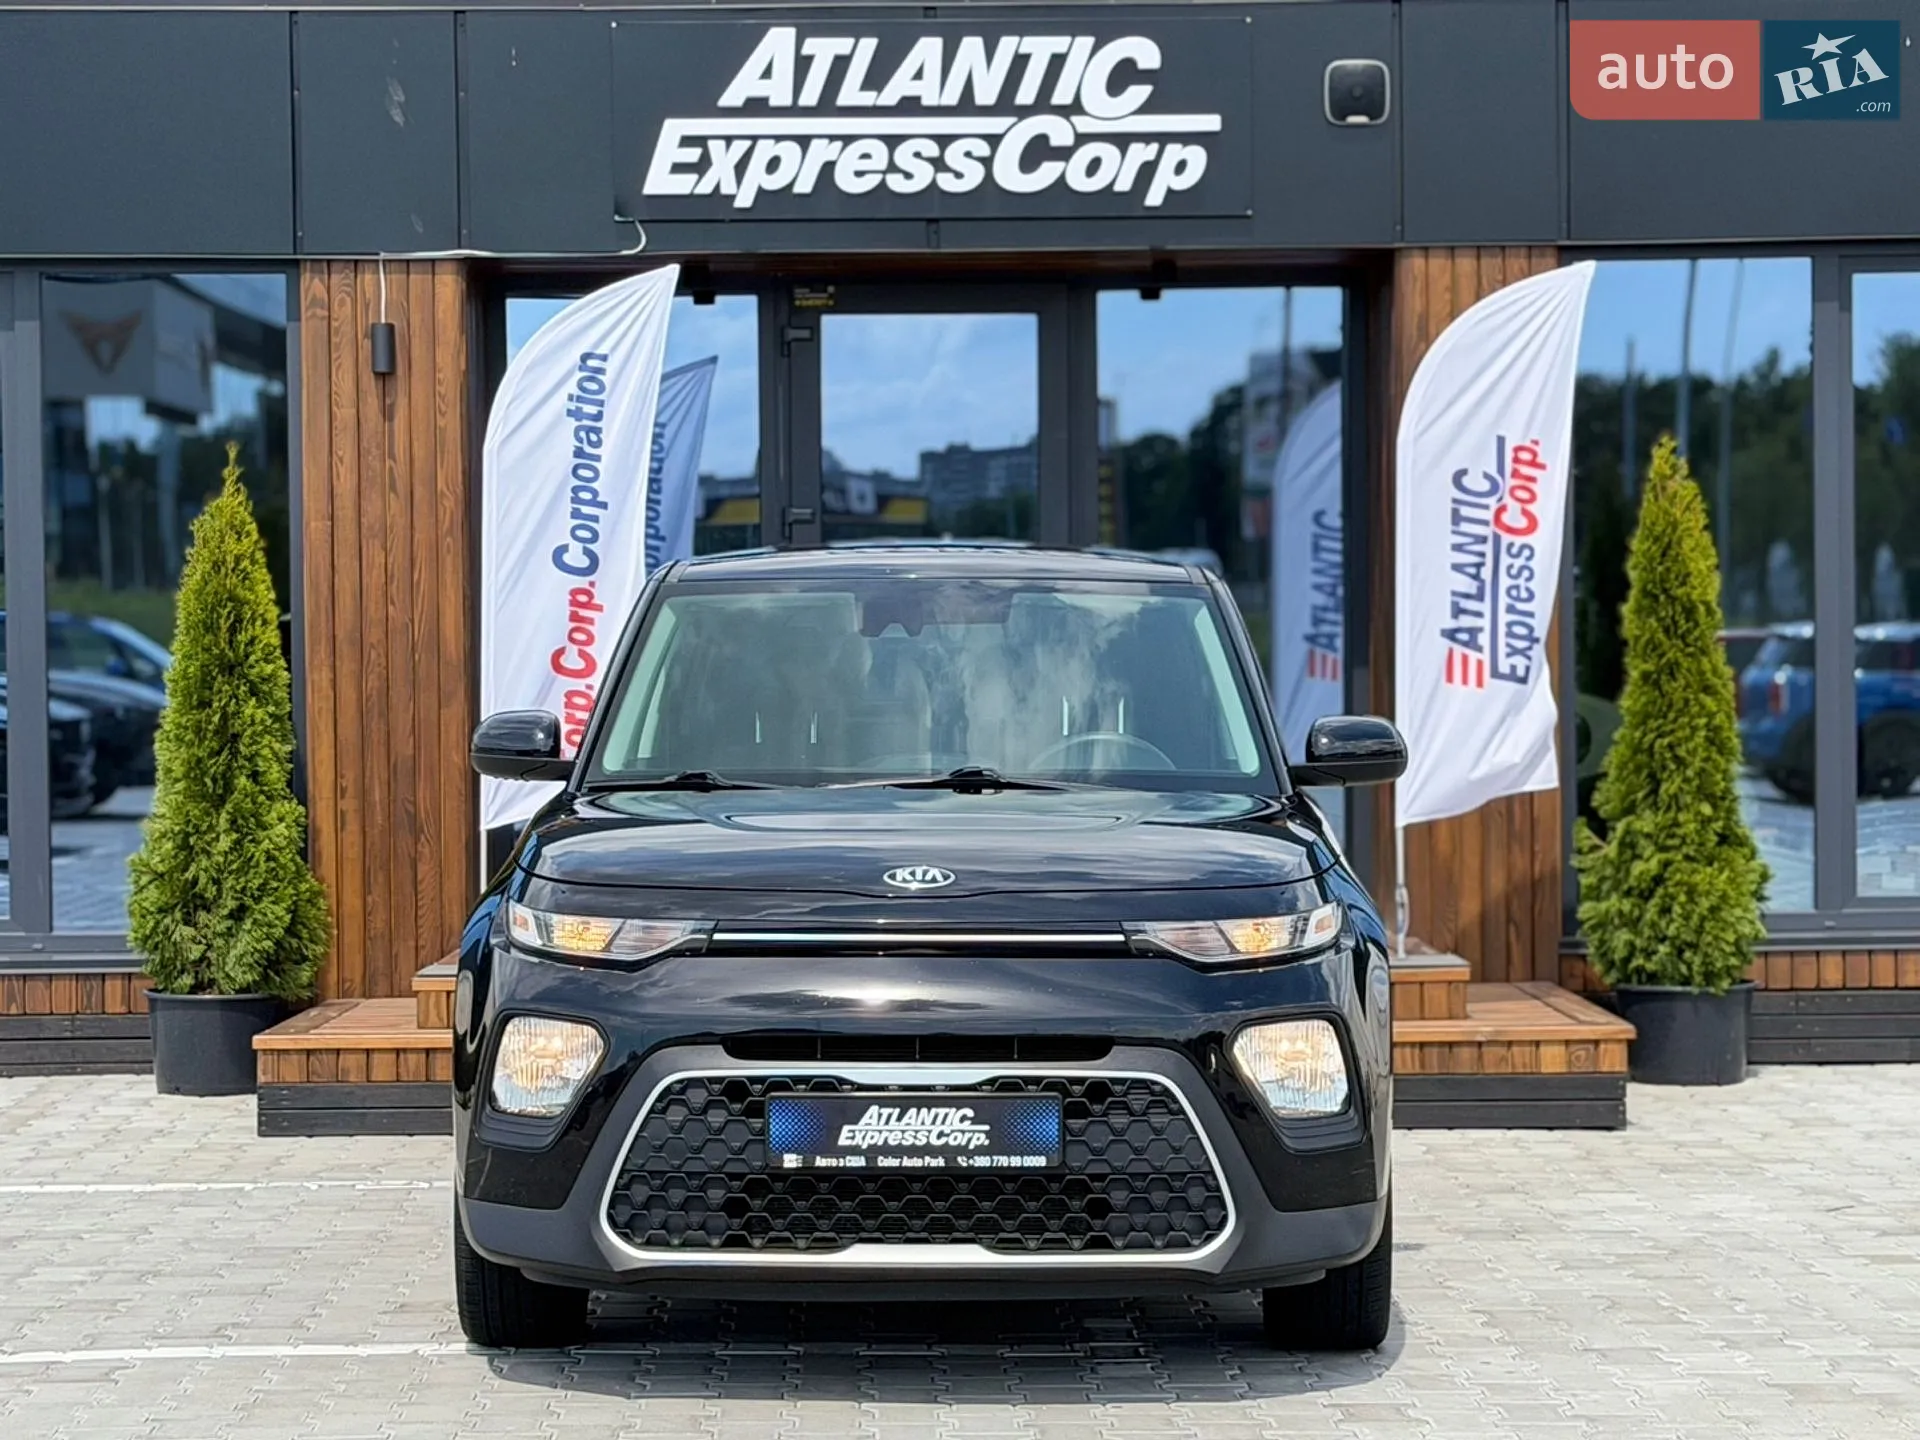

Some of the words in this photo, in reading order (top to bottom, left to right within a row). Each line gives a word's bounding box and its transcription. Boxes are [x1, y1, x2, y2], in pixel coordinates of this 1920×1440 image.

[717, 26, 1162, 118] ATLANTIC
[1302, 509, 1342, 653] ATLANTIC
[1440, 468, 1500, 655] ATLANTIC
[561, 684, 596, 758] orp.
[895, 868, 944, 882] KIA
[857, 1104, 975, 1127] ATLANTIC
[902, 1155, 923, 1167] Auto
[924, 1155, 945, 1167] Park
